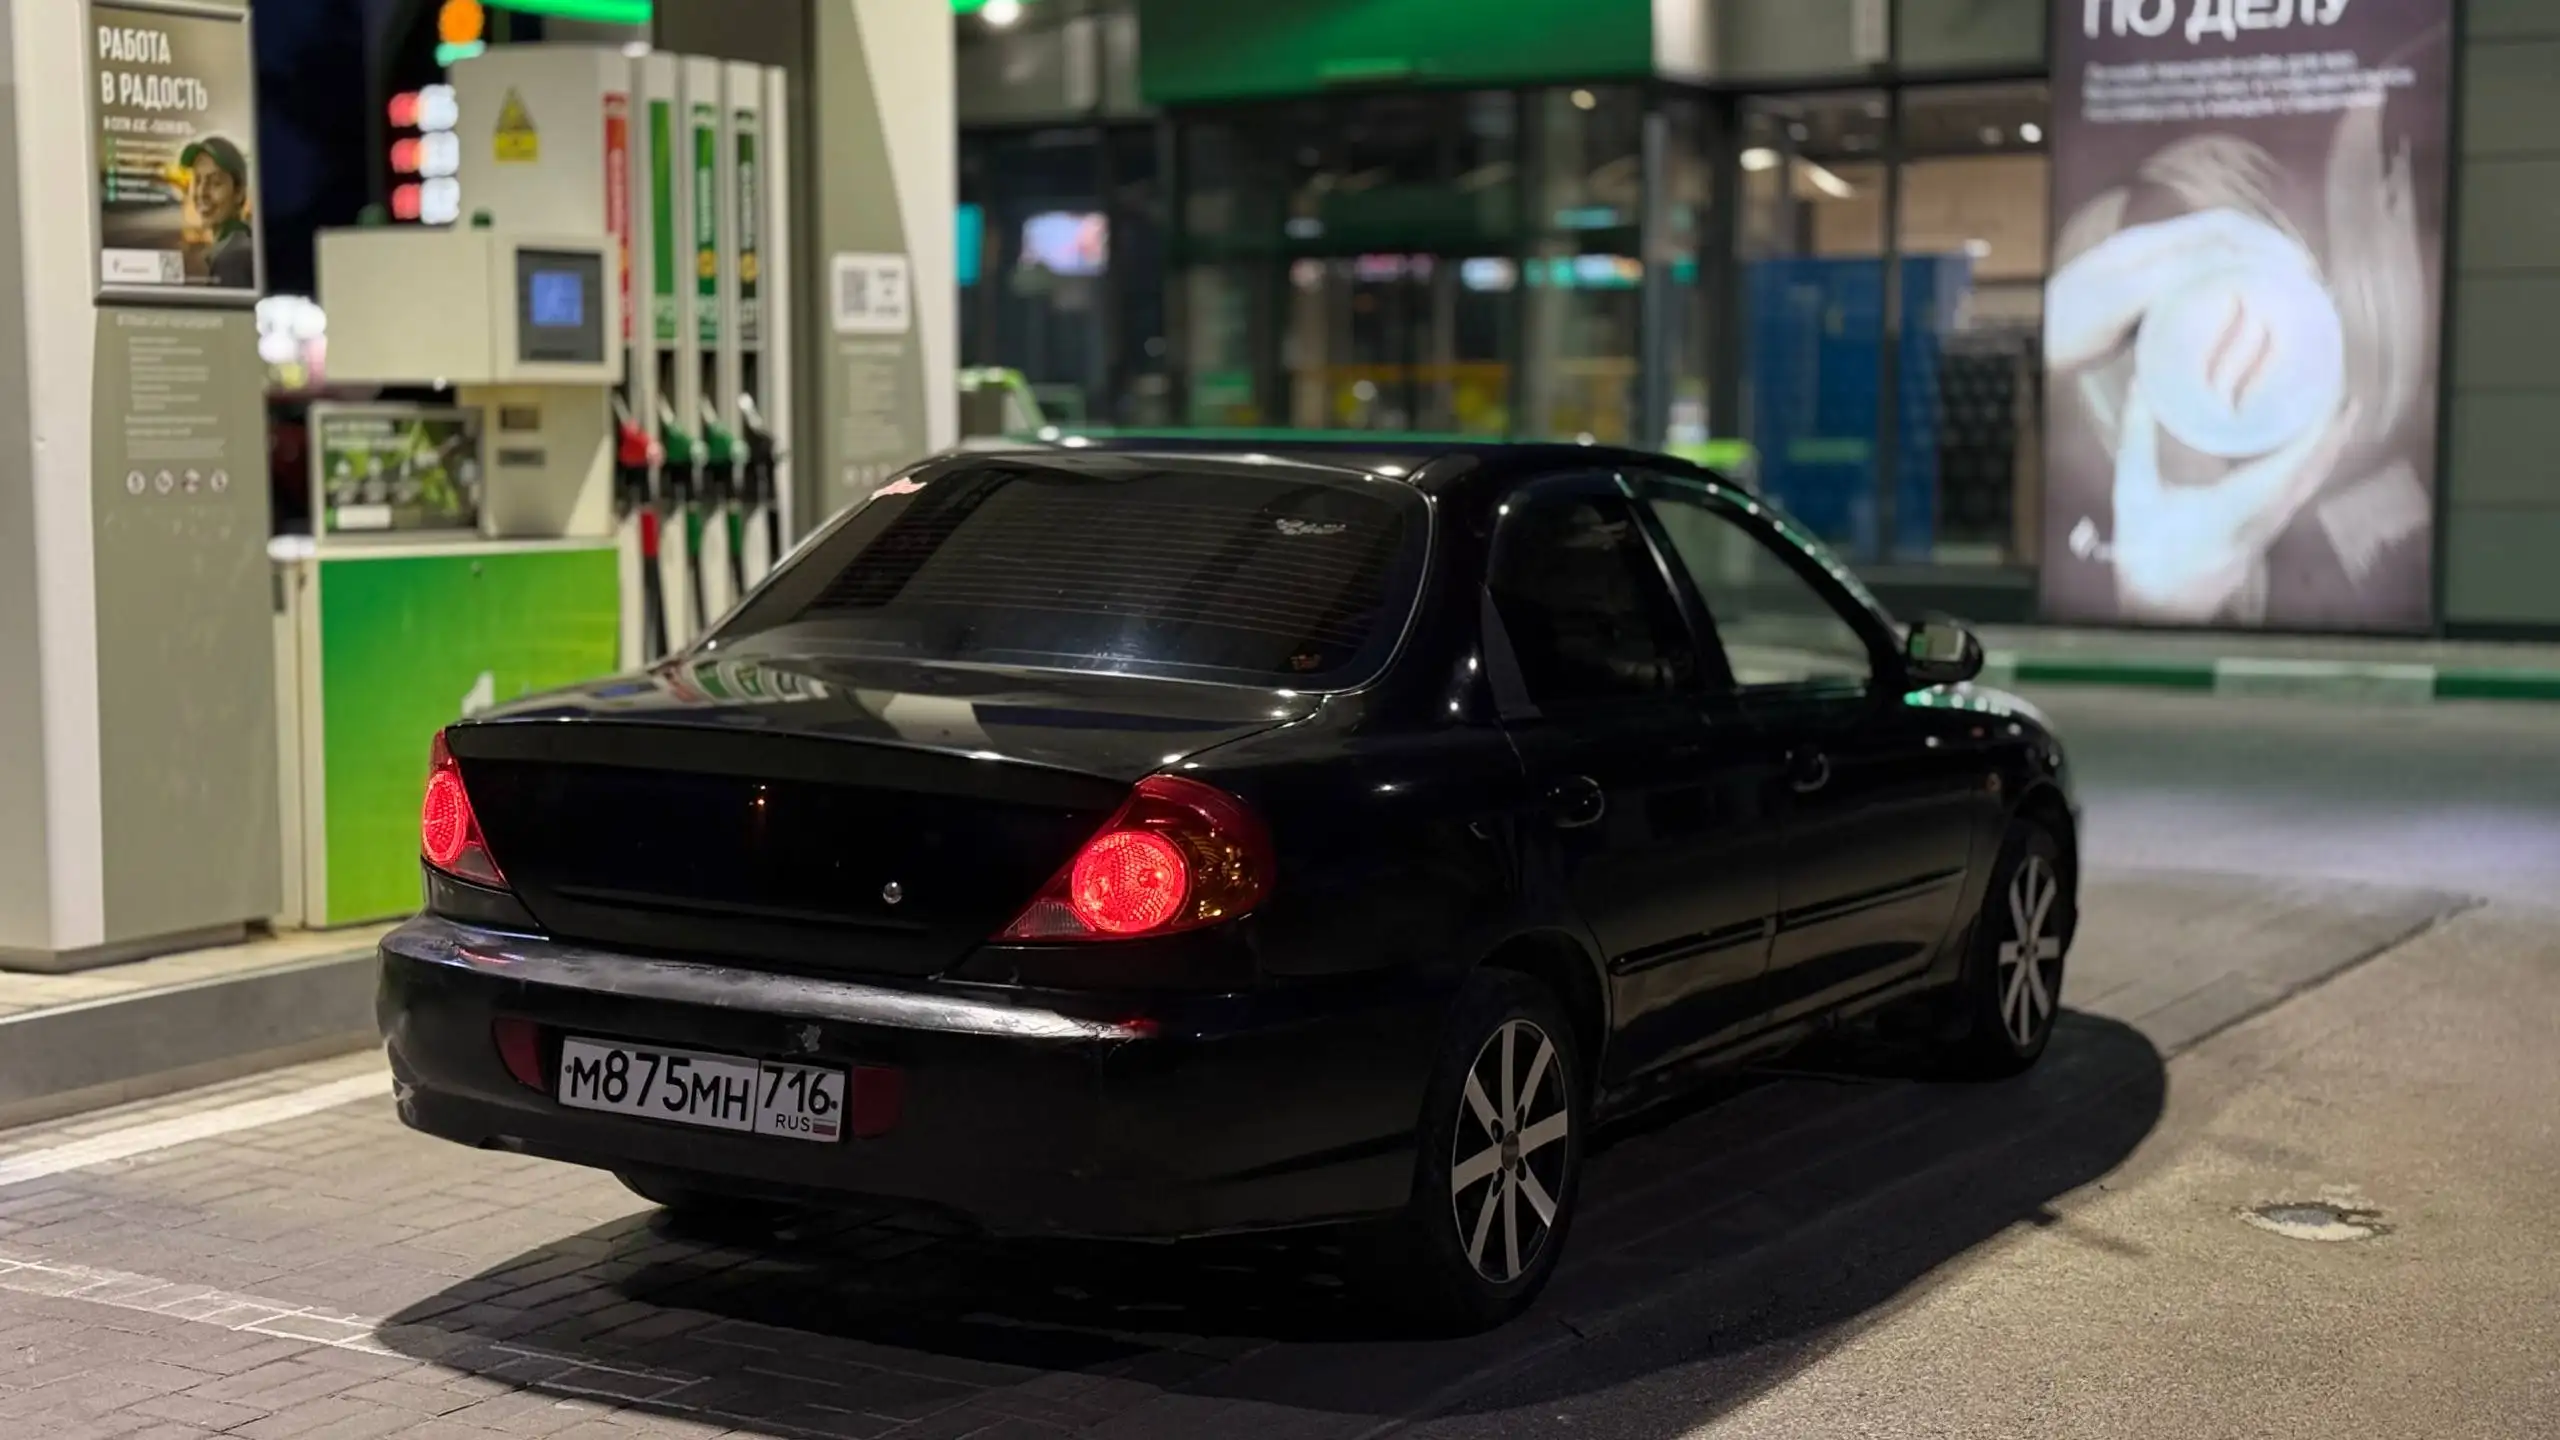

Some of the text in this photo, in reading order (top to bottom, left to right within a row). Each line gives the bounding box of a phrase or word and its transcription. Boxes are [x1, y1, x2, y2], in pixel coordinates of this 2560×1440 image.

[2083, 0, 2176, 39] ПО
[98, 26, 171, 65] РАБОТА
[101, 71, 208, 111] В РАДОСТЬ
[569, 1049, 831, 1122] М875МН 716
[775, 1114, 811, 1132] RUS
